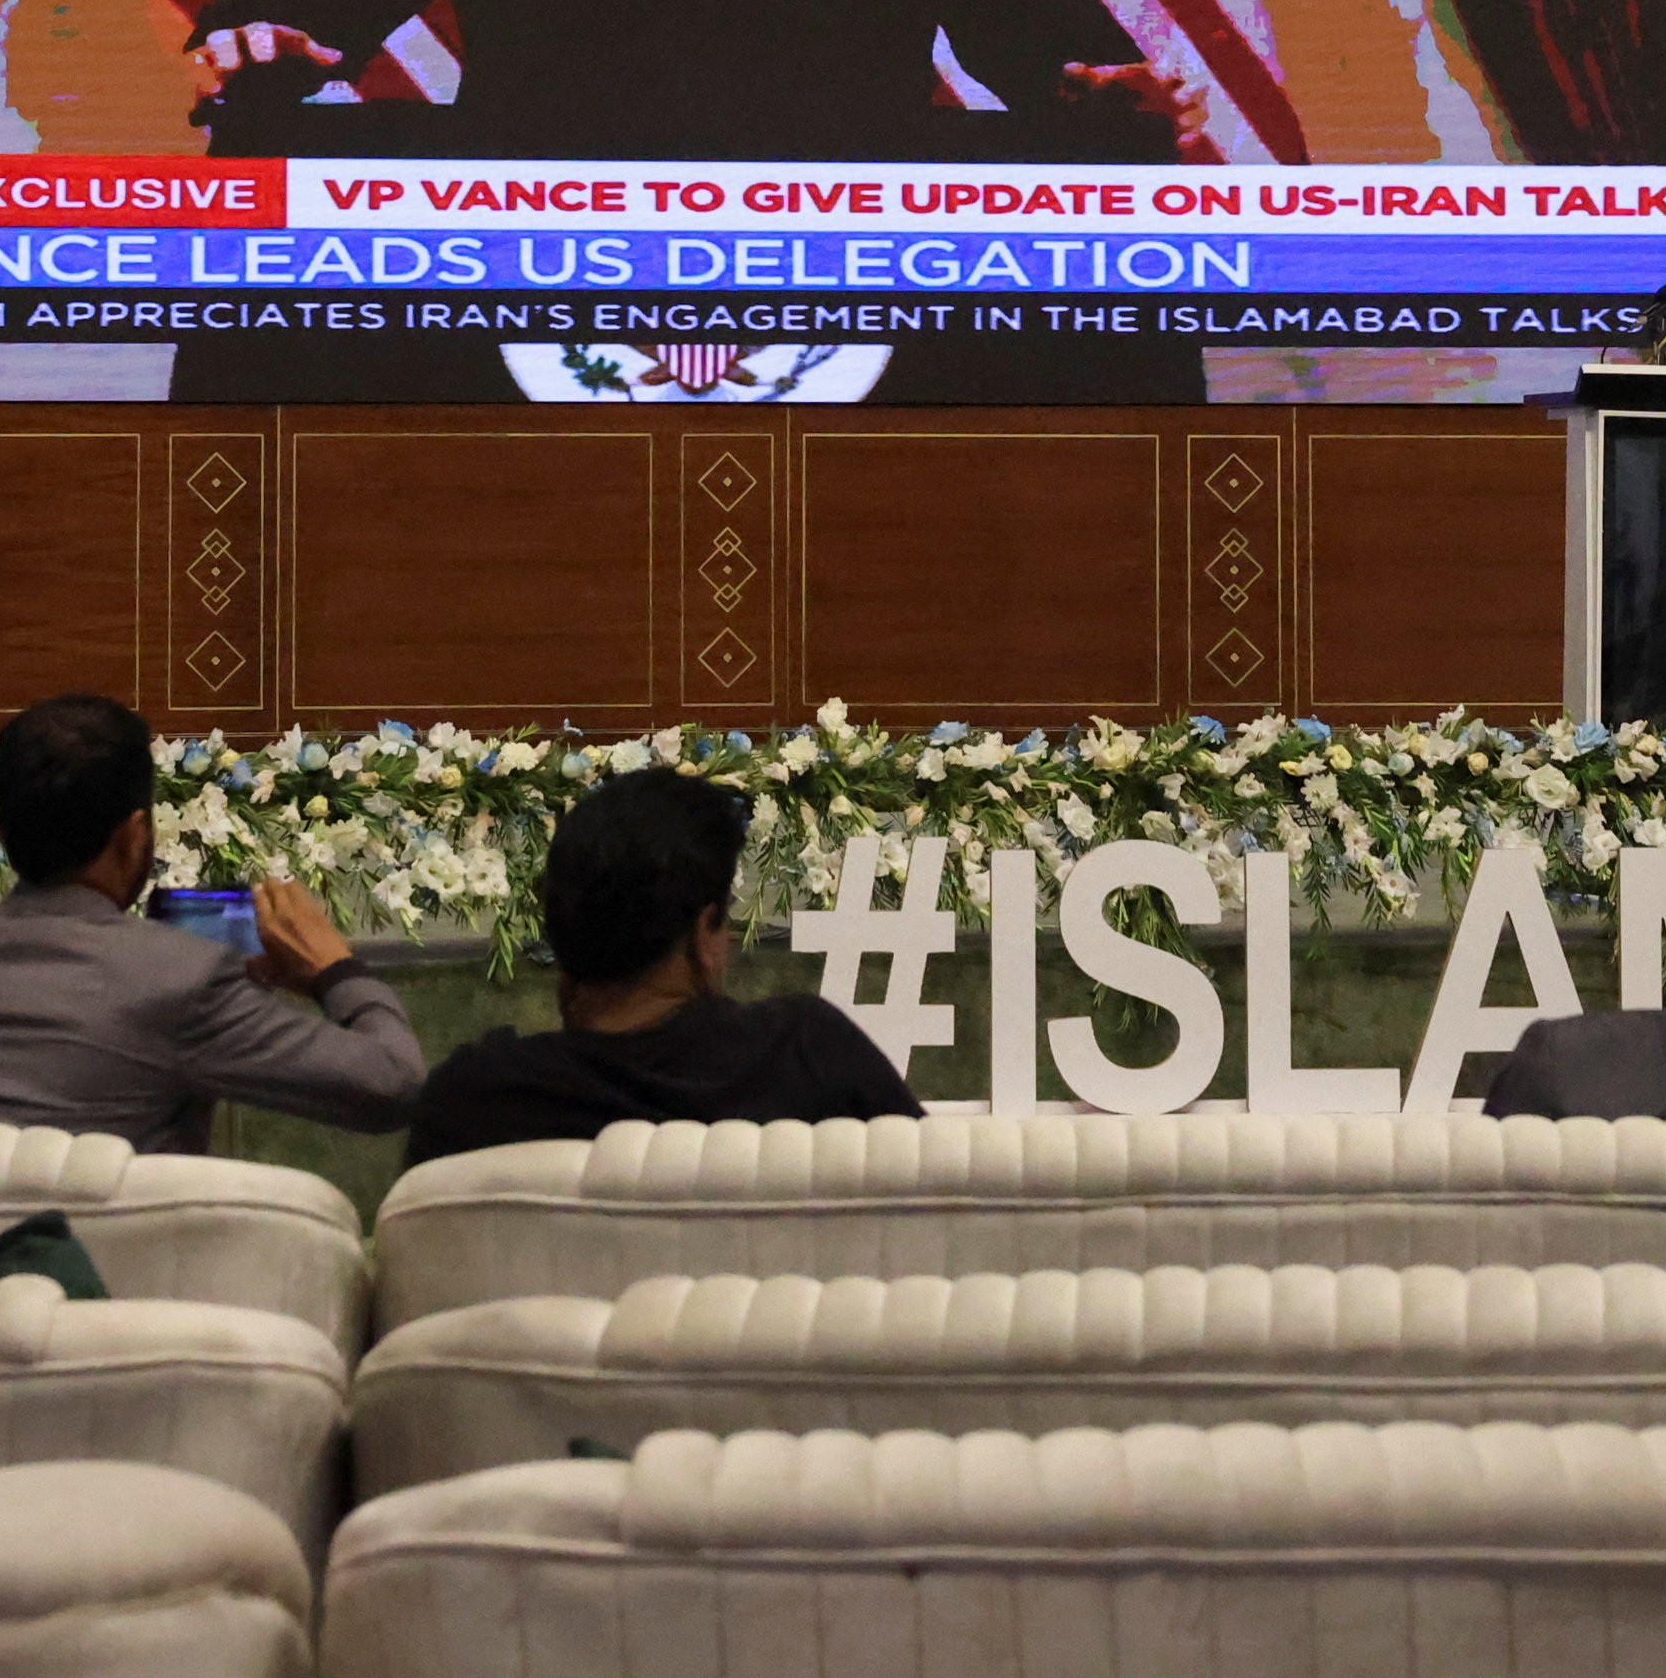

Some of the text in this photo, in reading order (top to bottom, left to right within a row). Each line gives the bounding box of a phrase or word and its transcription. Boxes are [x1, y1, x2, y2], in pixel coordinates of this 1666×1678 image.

[324, 179, 406, 212] VP
[421, 180, 628, 214] VANCE
[643, 181, 727, 214] TO
[743, 181, 885, 215] GIVE
[902, 184, 1136, 217] UPDATE
[1152, 184, 1242, 217] ON
[1260, 185, 1507, 218] US-IRAN
[191, 236, 489, 285] LEADS
[521, 237, 633, 287] US
[667, 239, 1251, 289] DELEGATION
[27, 302, 386, 330] APPRECIATES
[406, 303, 575, 331] IRAN'S
[594, 305, 956, 332] ENGAGEMENT
[975, 307, 1022, 332] IN
[1041, 306, 1140, 333] THE
[1159, 307, 1462, 334] ISLAMABAD
[1480, 307, 1644, 334] TALKS
